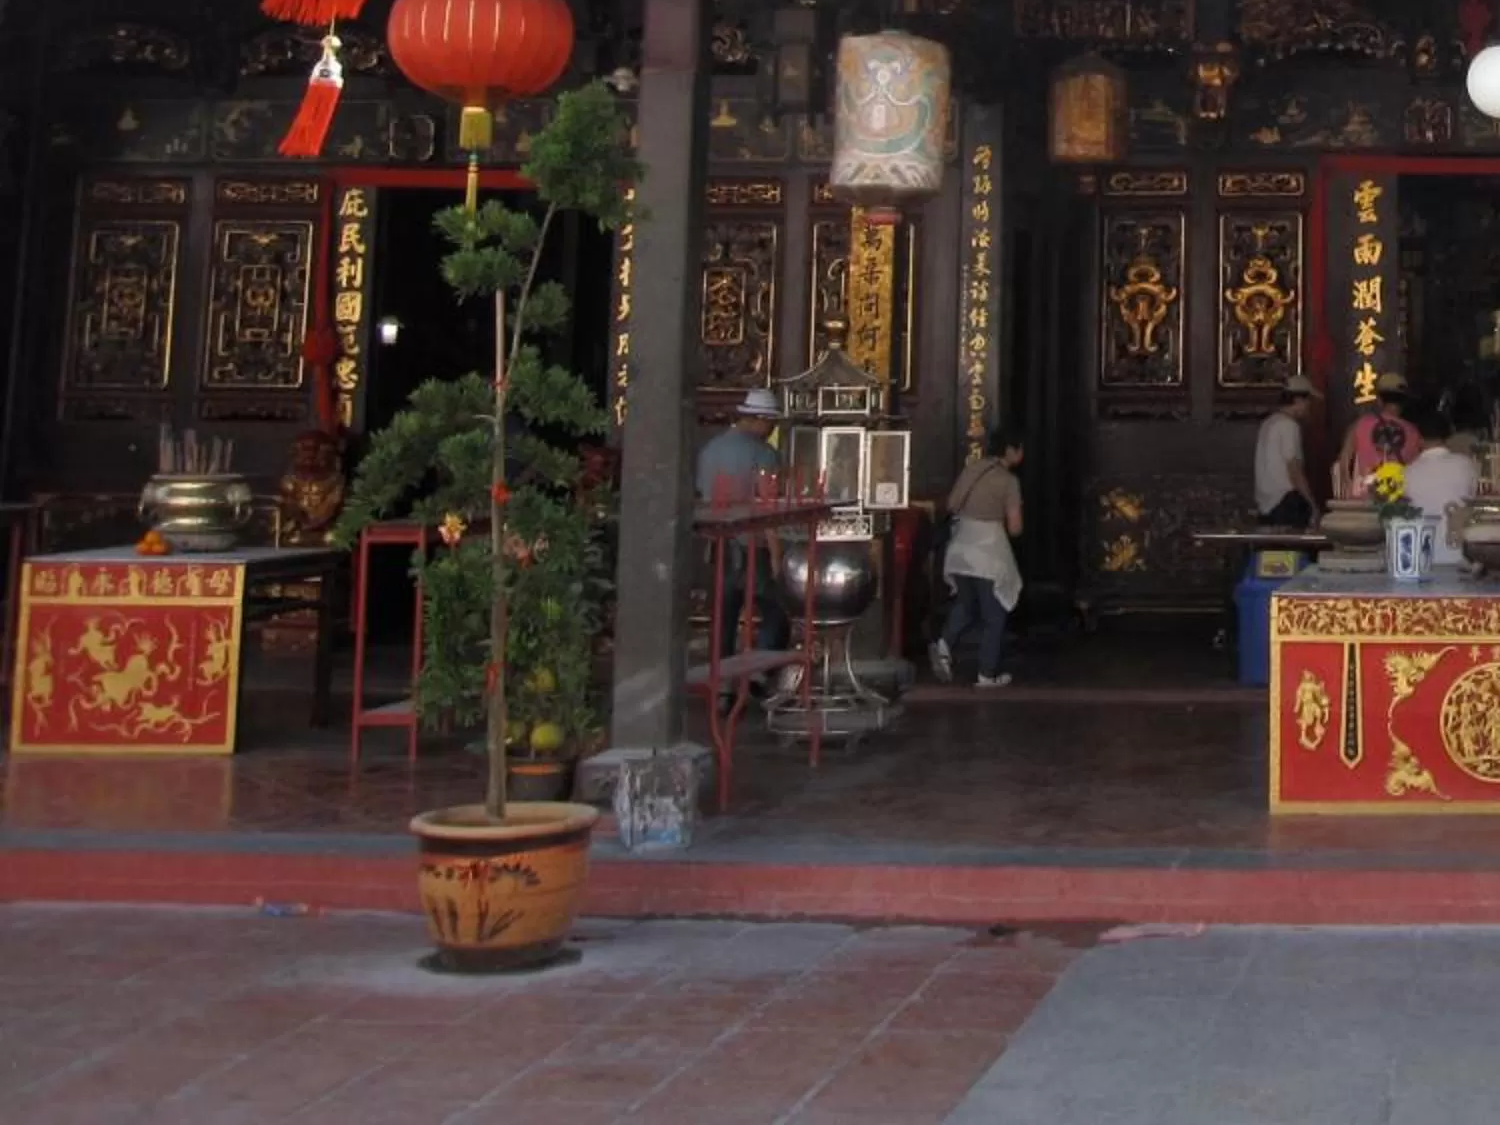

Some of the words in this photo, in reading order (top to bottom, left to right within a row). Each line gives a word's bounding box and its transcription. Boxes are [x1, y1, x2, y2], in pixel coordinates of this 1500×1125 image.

[1353, 179, 1385, 404] 雲雨潤蒼生
